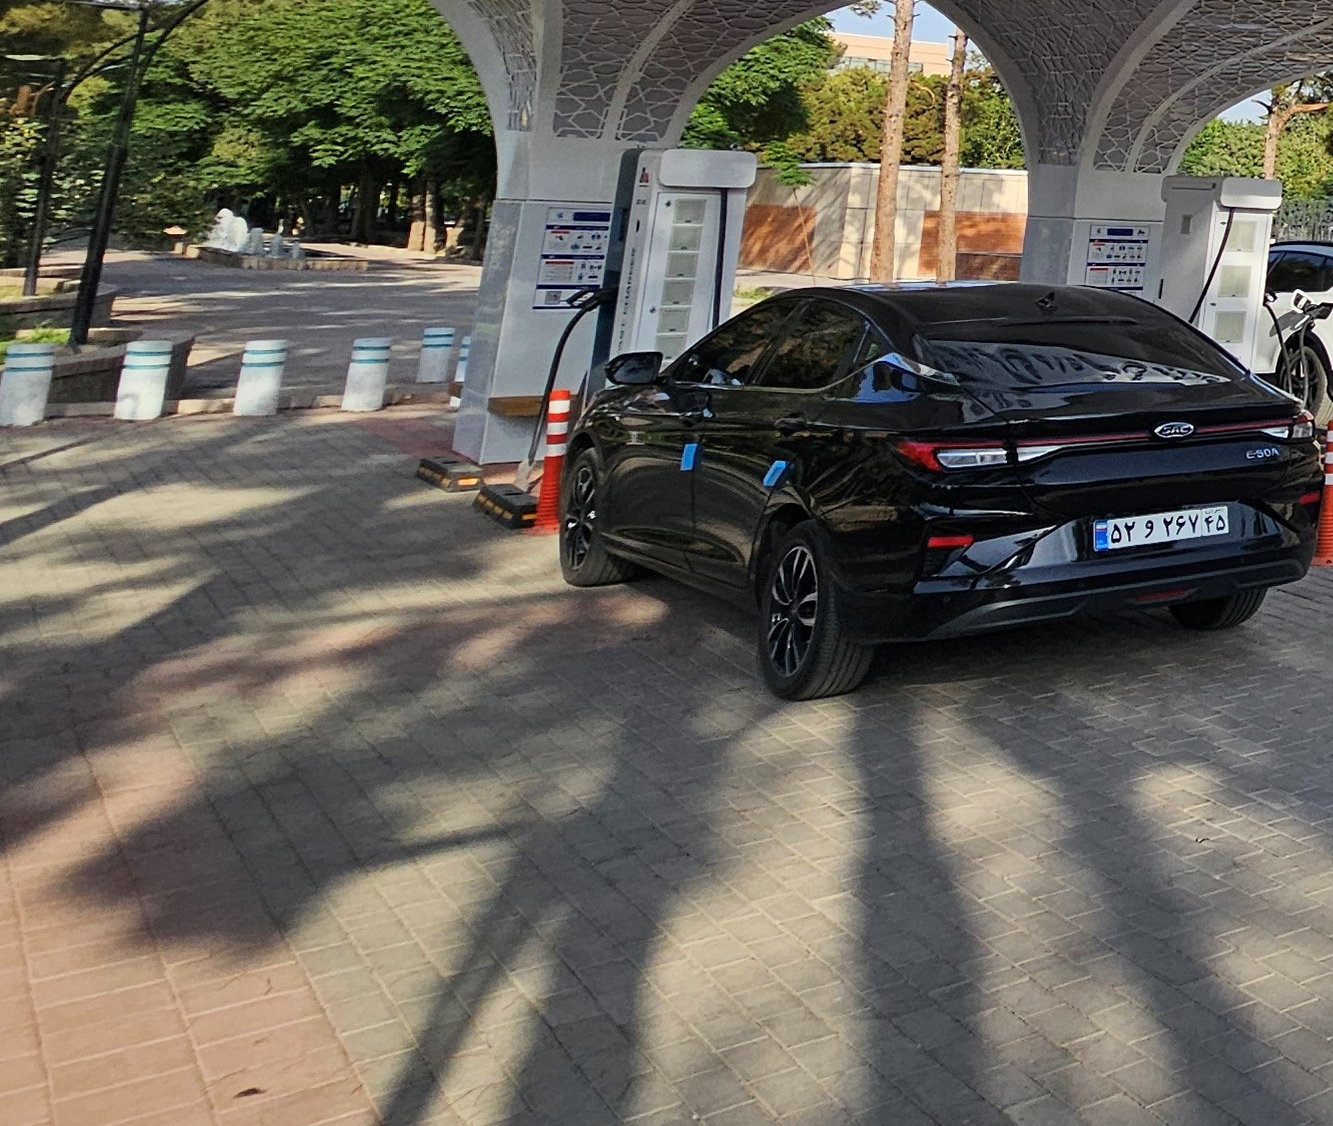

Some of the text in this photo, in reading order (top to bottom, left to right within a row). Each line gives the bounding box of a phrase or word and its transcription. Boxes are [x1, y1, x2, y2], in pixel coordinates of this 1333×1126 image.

[1110, 521, 1136, 544] ۵۲
[1162, 513, 1199, 537] ۲۶۷
[1203, 514, 1226, 533] ۴۵
